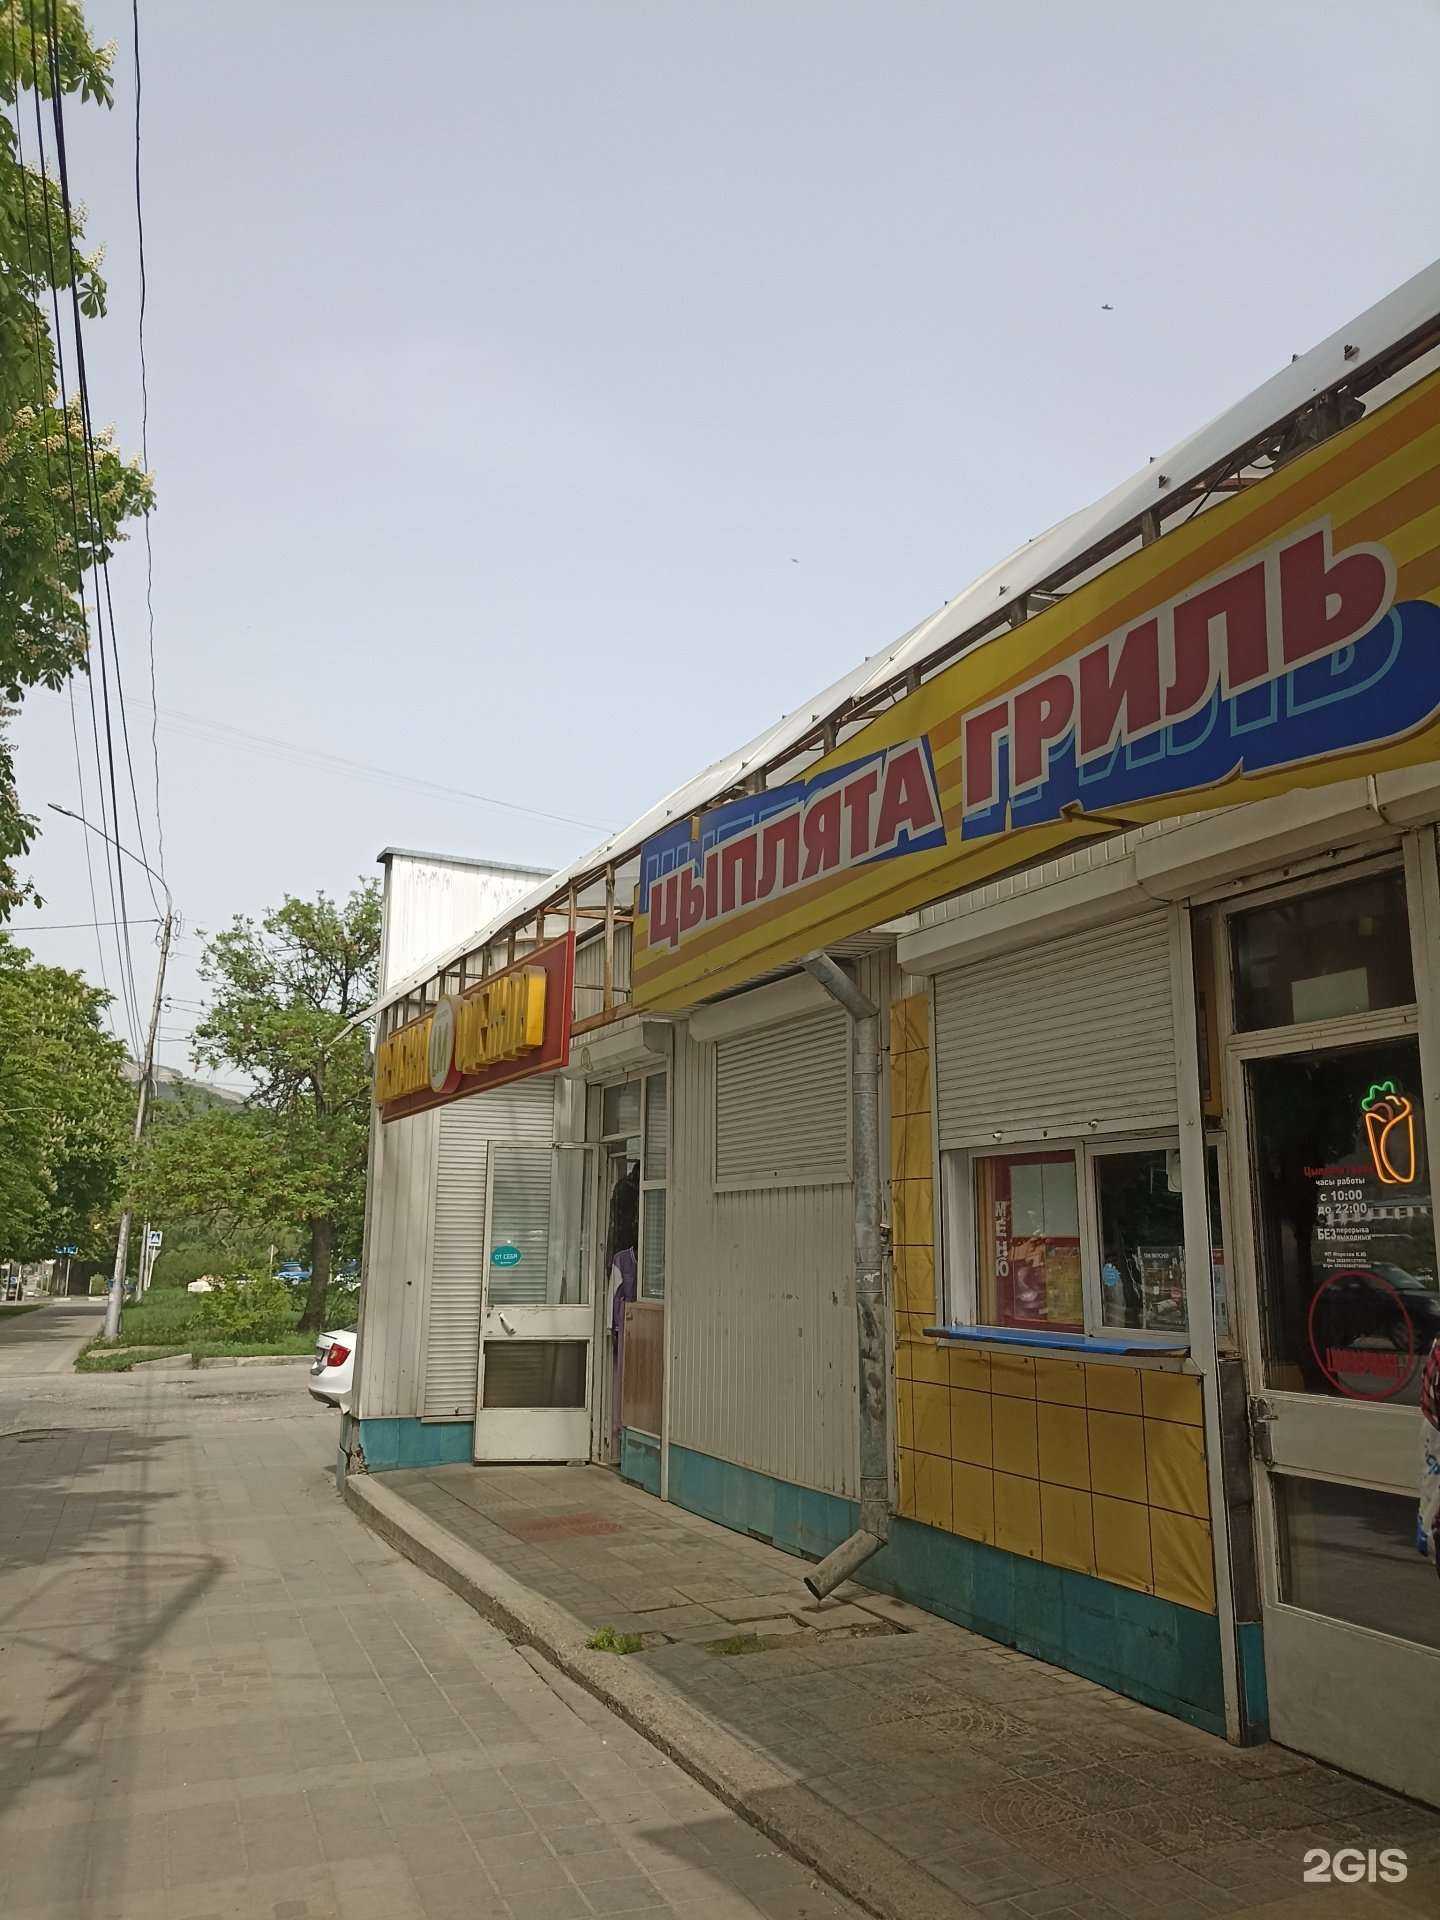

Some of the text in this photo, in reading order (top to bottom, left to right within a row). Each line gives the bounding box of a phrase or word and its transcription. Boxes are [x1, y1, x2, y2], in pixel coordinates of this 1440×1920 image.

[648, 514, 1398, 950] ЦЫПЛЯТА ГРИЛЬ
[1337, 1177, 1365, 1186] работы
[1331, 1190, 1363, 1201] 10:00
[1317, 1203, 1368, 1216] до 22:00
[995, 1200, 1010, 1277] МЕНЮ
[1318, 1228, 1337, 1241] БЕЗ
